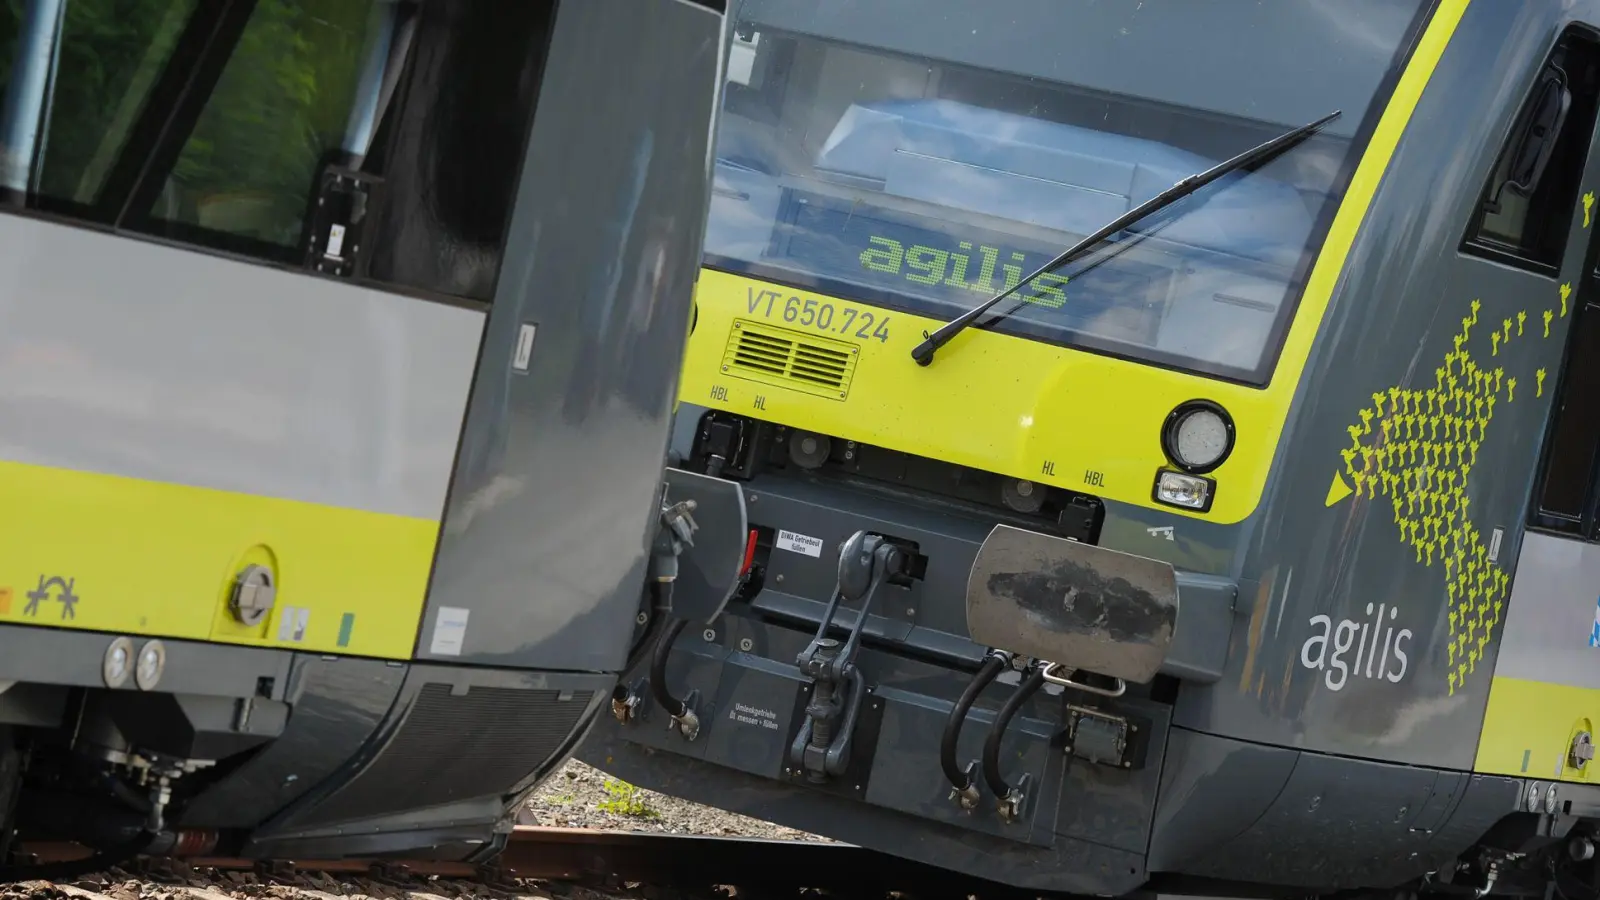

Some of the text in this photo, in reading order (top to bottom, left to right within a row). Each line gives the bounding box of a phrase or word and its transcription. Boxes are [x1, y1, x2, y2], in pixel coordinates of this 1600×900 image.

[859, 235, 1069, 308] agilis
[748, 287, 890, 343] VT 650.724
[710, 385, 728, 402] HBL
[753, 395, 766, 411] HL
[1041, 460, 1055, 476] HL
[1083, 469, 1105, 487] HBL
[1300, 602, 1413, 691] agilis
